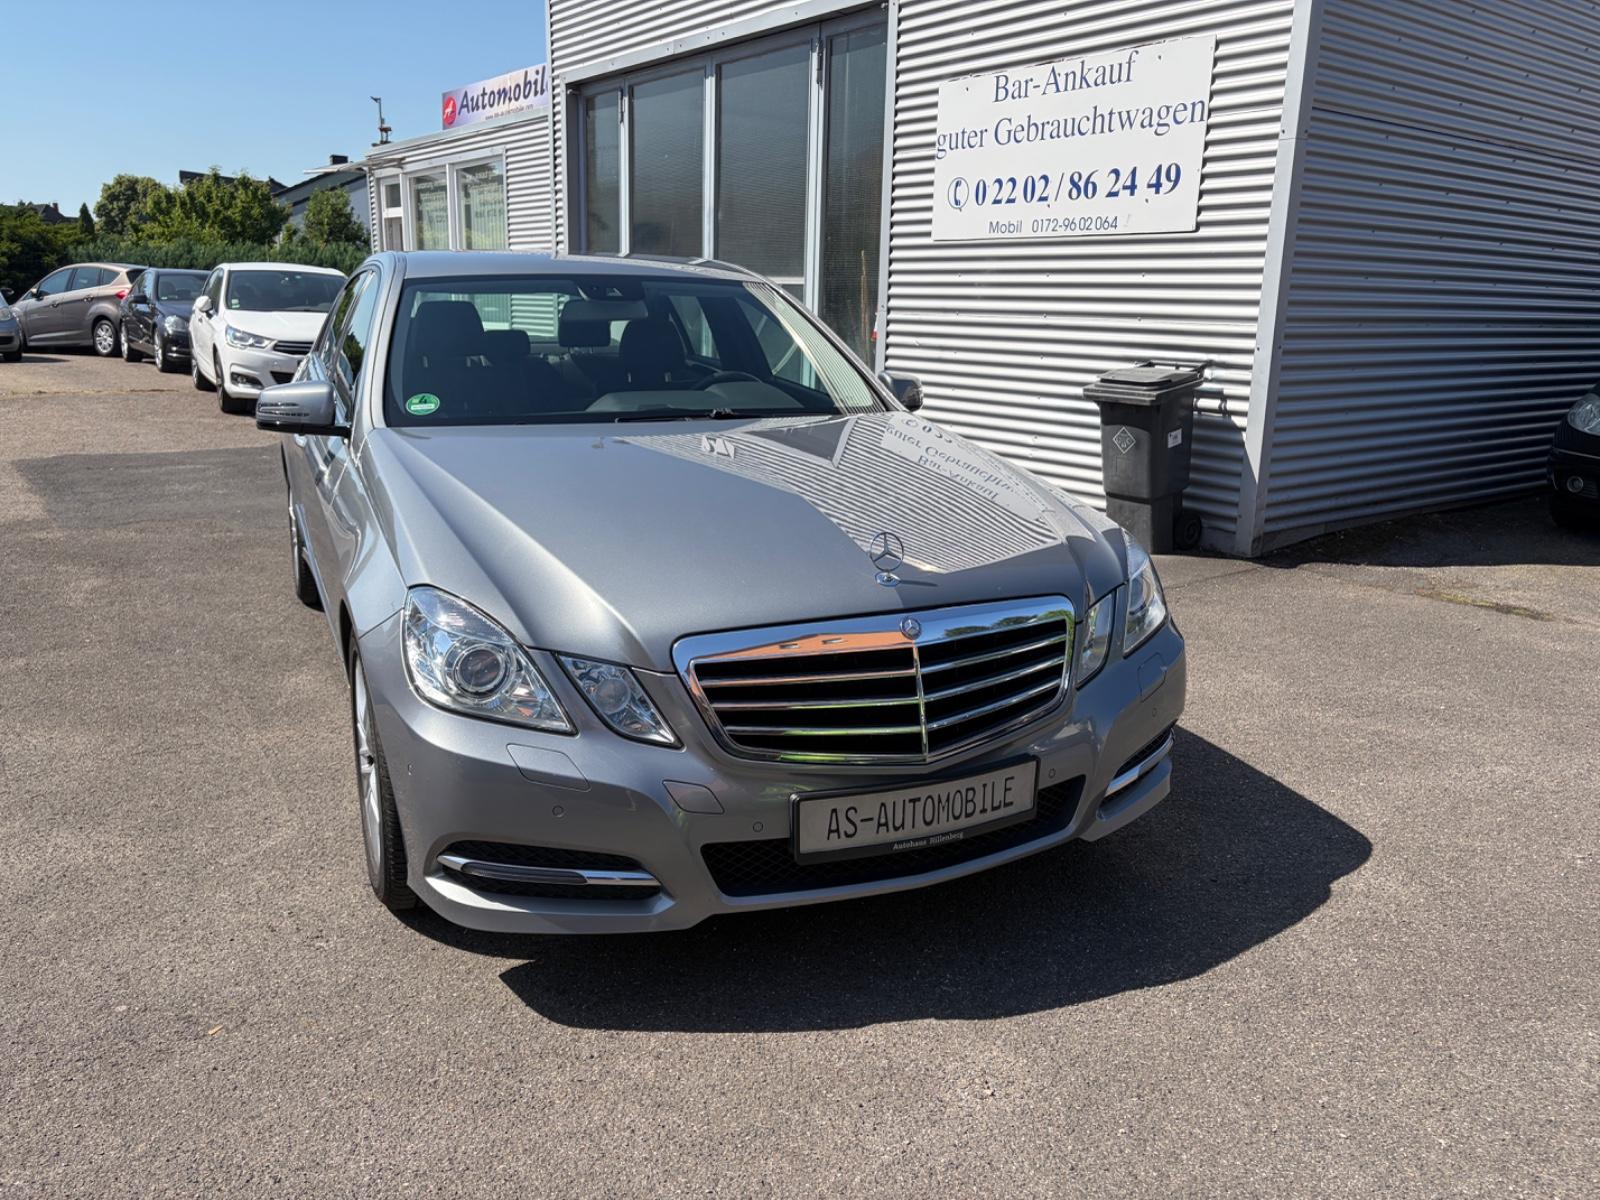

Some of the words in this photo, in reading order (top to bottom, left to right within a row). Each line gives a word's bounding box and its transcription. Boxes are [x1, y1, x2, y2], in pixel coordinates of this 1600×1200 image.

[458, 65, 549, 115] Automobil
[994, 50, 1138, 102] Bar-Ankauf
[936, 127, 988, 159] guter
[994, 98, 1206, 146] Gebrauchtwagen
[988, 220, 1023, 234] Mobil
[827, 776, 1015, 840] AS-AUTOMOBILE
[892, 839, 928, 851] Autohaus
